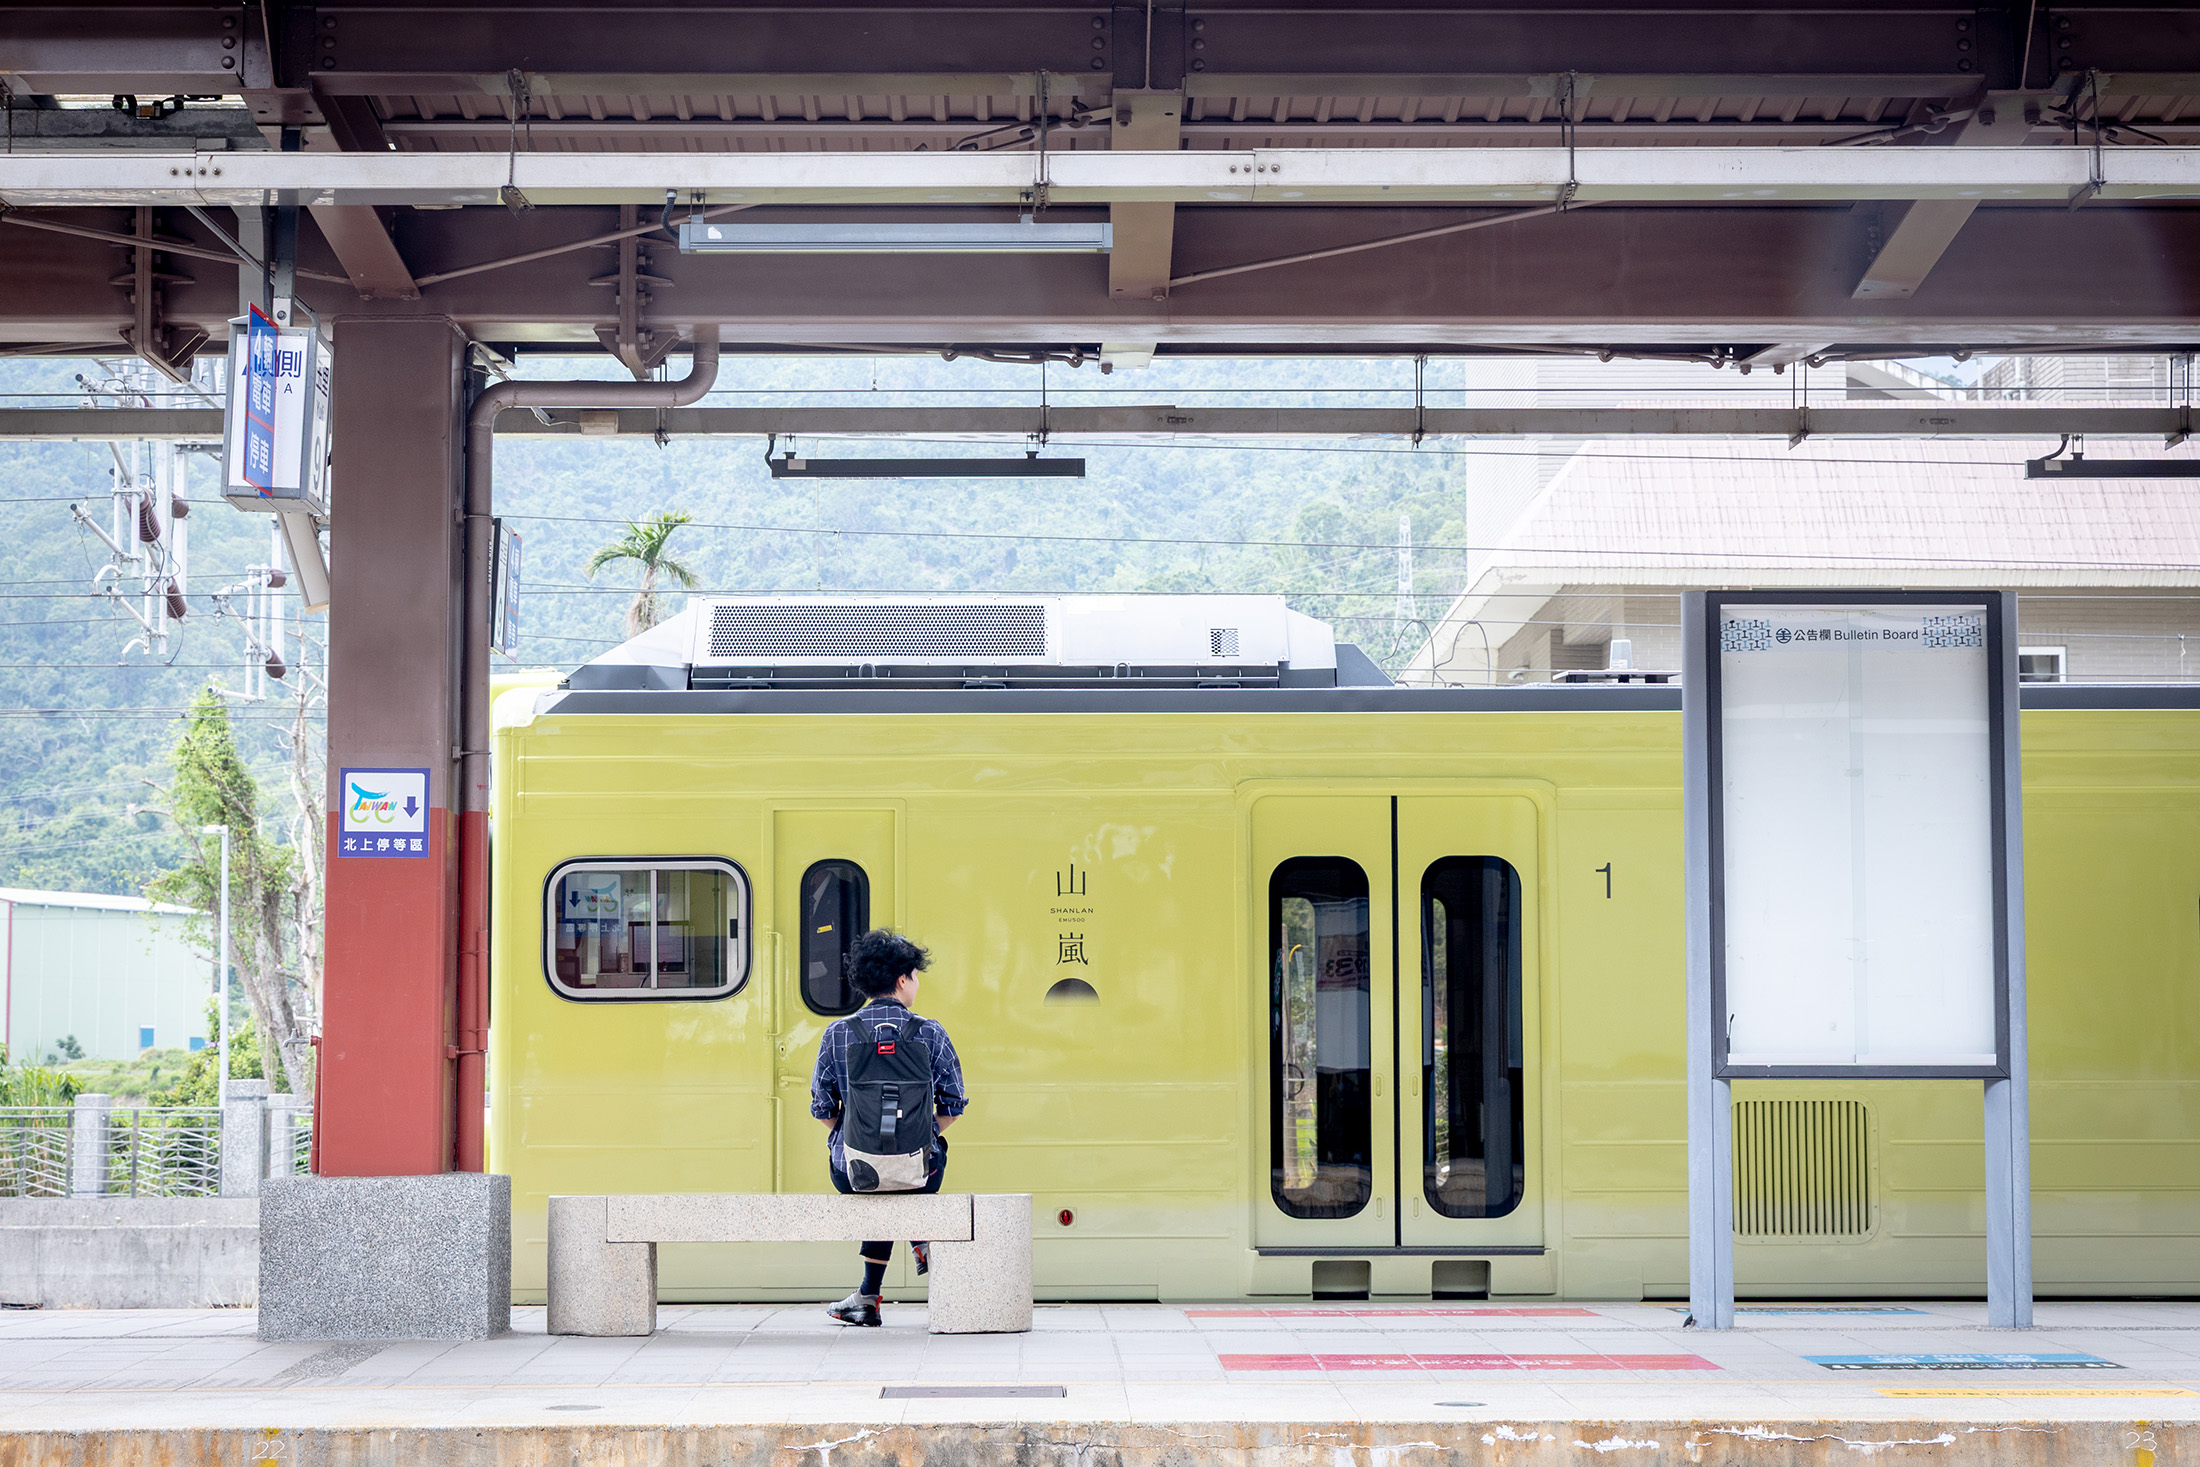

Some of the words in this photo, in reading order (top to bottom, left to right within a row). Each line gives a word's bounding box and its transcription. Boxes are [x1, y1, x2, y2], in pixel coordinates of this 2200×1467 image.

[252, 371, 272, 415] 電車
[284, 383, 293, 394] A
[250, 431, 270, 474] 停車
[313, 436, 321, 490] 9
[1793, 629, 1831, 641] 公告欄
[1834, 629, 1879, 641] Bulletin
[1882, 629, 1919, 640] Board
[351, 782, 398, 811] TAIWAN
[343, 837, 424, 852] 北上停等區
[1056, 863, 1086, 897] 山
[1595, 862, 1612, 899] 1
[1056, 932, 1089, 966] 嵐
[252, 1440, 287, 1460] 22
[2125, 1430, 2158, 1452] 23
